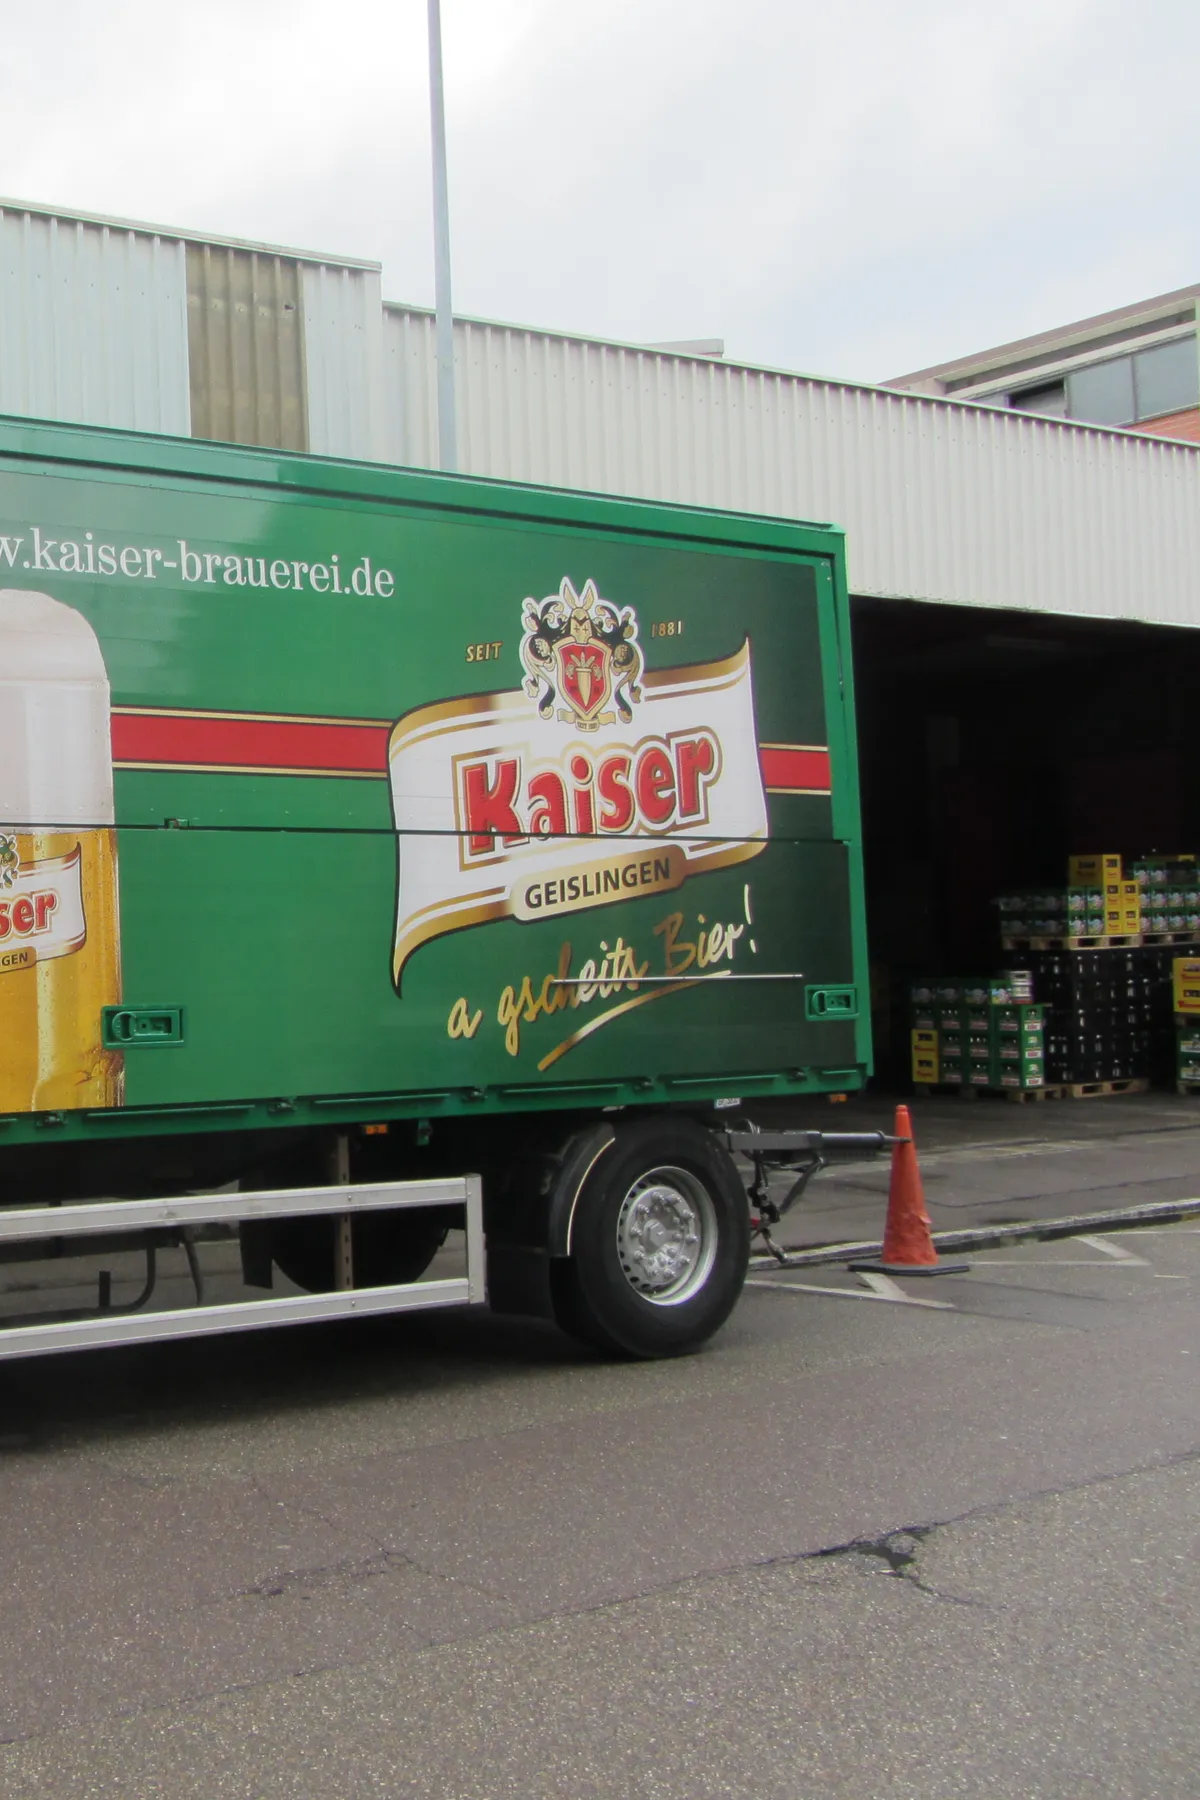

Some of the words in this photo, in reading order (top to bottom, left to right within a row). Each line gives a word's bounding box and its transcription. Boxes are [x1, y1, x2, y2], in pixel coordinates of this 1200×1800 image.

[464, 641, 503, 664] SEIT
[651, 620, 684, 639] 1881
[461, 737, 717, 855] Kaiser
[524, 857, 671, 910] GEISLINGEN
[447, 996, 483, 1040] a
[497, 937, 649, 1057] gscheits
[652, 884, 758, 977] Bier!
